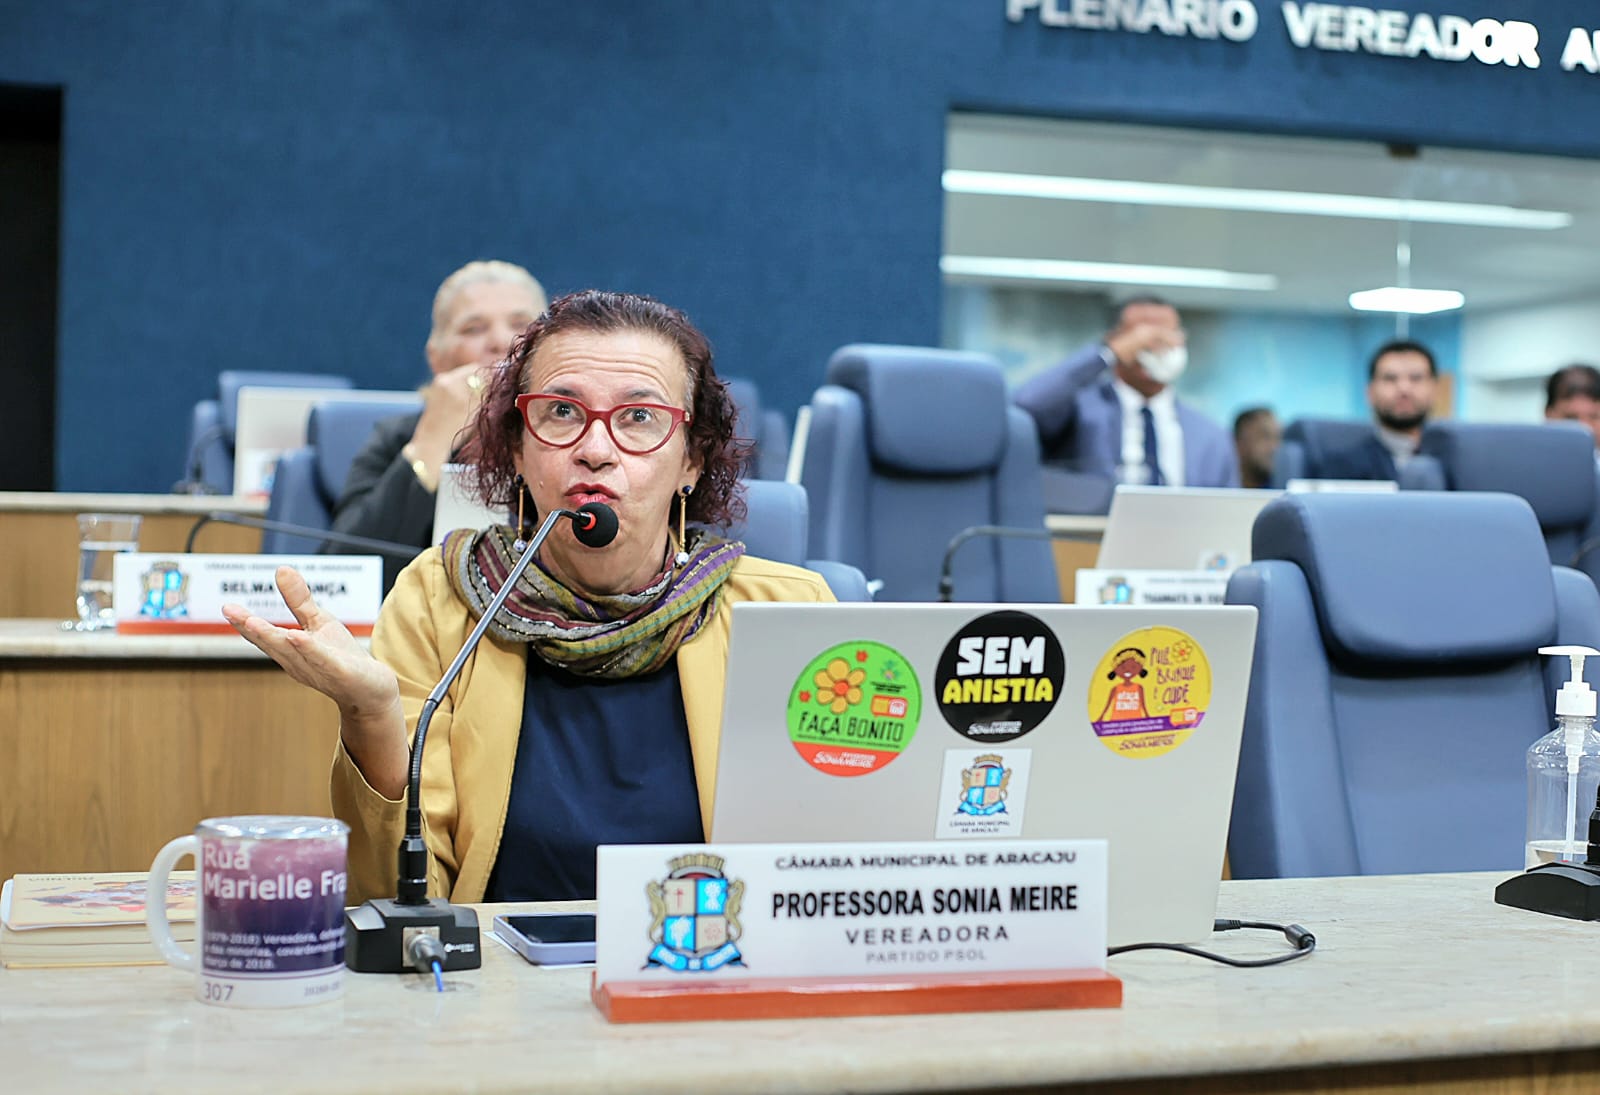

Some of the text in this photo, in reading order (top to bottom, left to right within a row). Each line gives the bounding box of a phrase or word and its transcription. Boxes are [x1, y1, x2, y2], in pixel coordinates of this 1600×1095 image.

[1282, 2, 1540, 68] VEREADOR
[956, 635, 1046, 676] SEM
[942, 677, 1054, 704] ANISTIA
[799, 711, 840, 736] FAÇA
[846, 716, 904, 742] BONITO
[203, 842, 250, 870] Rua
[775, 851, 1077, 870] CÂMARA MUNICIPAL DE ARACAJU
[203, 871, 313, 900] Marielle
[772, 885, 1078, 918] PROFESSORA SONIA MEIRE
[845, 925, 1009, 945] VEREADORA
[866, 949, 986, 963] PARTIDO PSOL
[203, 982, 234, 1001] 307
